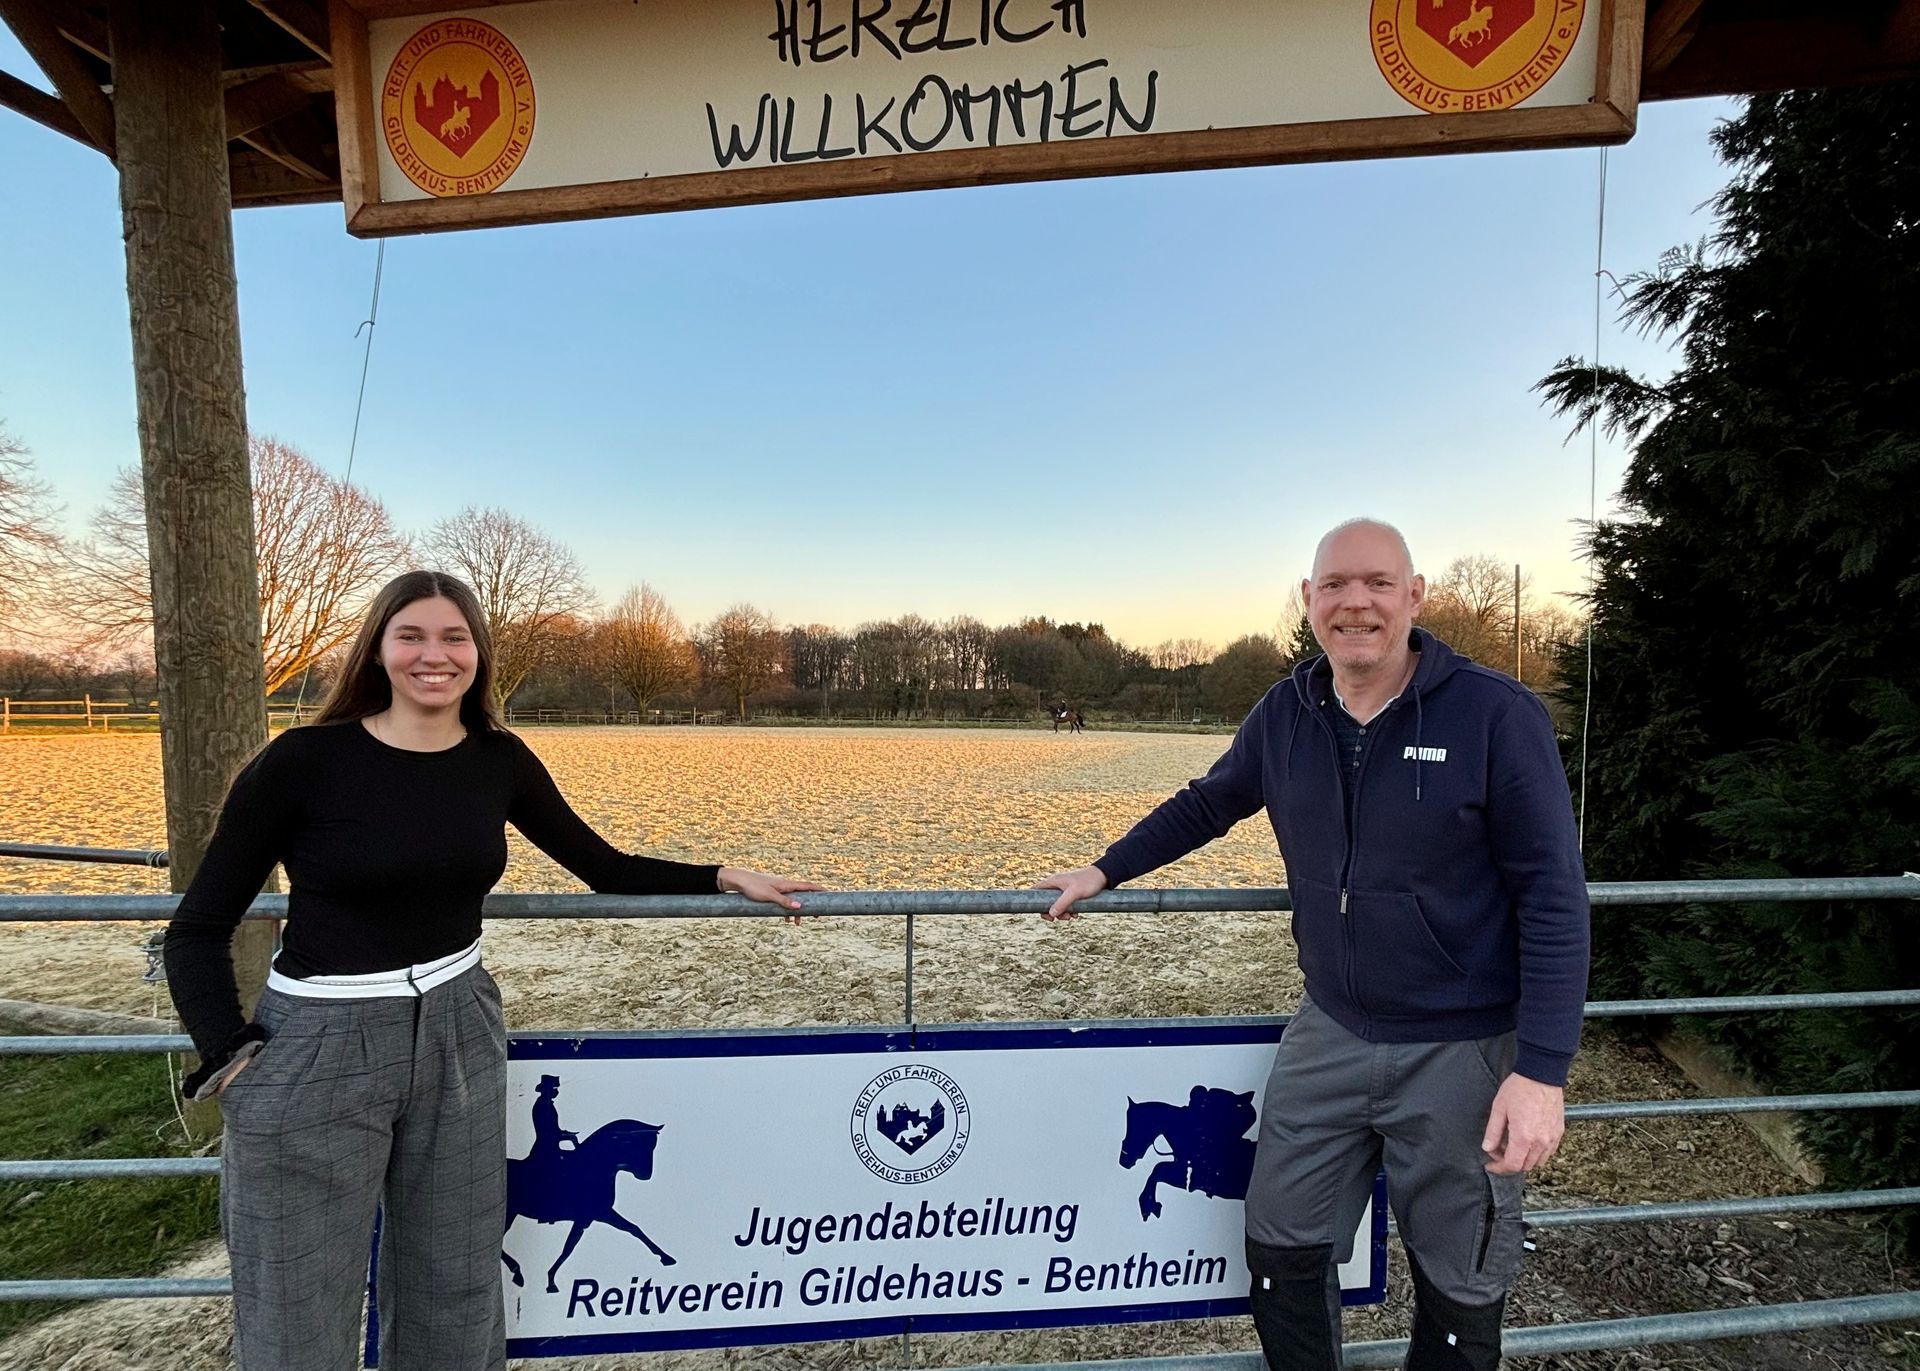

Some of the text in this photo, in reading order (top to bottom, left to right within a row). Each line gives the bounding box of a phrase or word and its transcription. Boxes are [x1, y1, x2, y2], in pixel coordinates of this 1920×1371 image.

[388, 23, 528, 98] REIT- UND FAHRVEREIN
[1376, 20, 1562, 111] GILDEHAUS-BENTHEIM
[706, 59, 1158, 168] WILLKOMMEN
[387, 117, 523, 194] GILDEHAUS-BENTHEIM
[1403, 746, 1447, 762] PUMA
[855, 1067, 967, 1118] REIT- UND FAHRVEREIN
[854, 1133, 958, 1182] GILDEHAUS-BENTHEIM
[734, 1198, 1079, 1255] Jugendabteilung
[566, 1249, 1227, 1318] Reitverein Gildehaus - Bentheim
